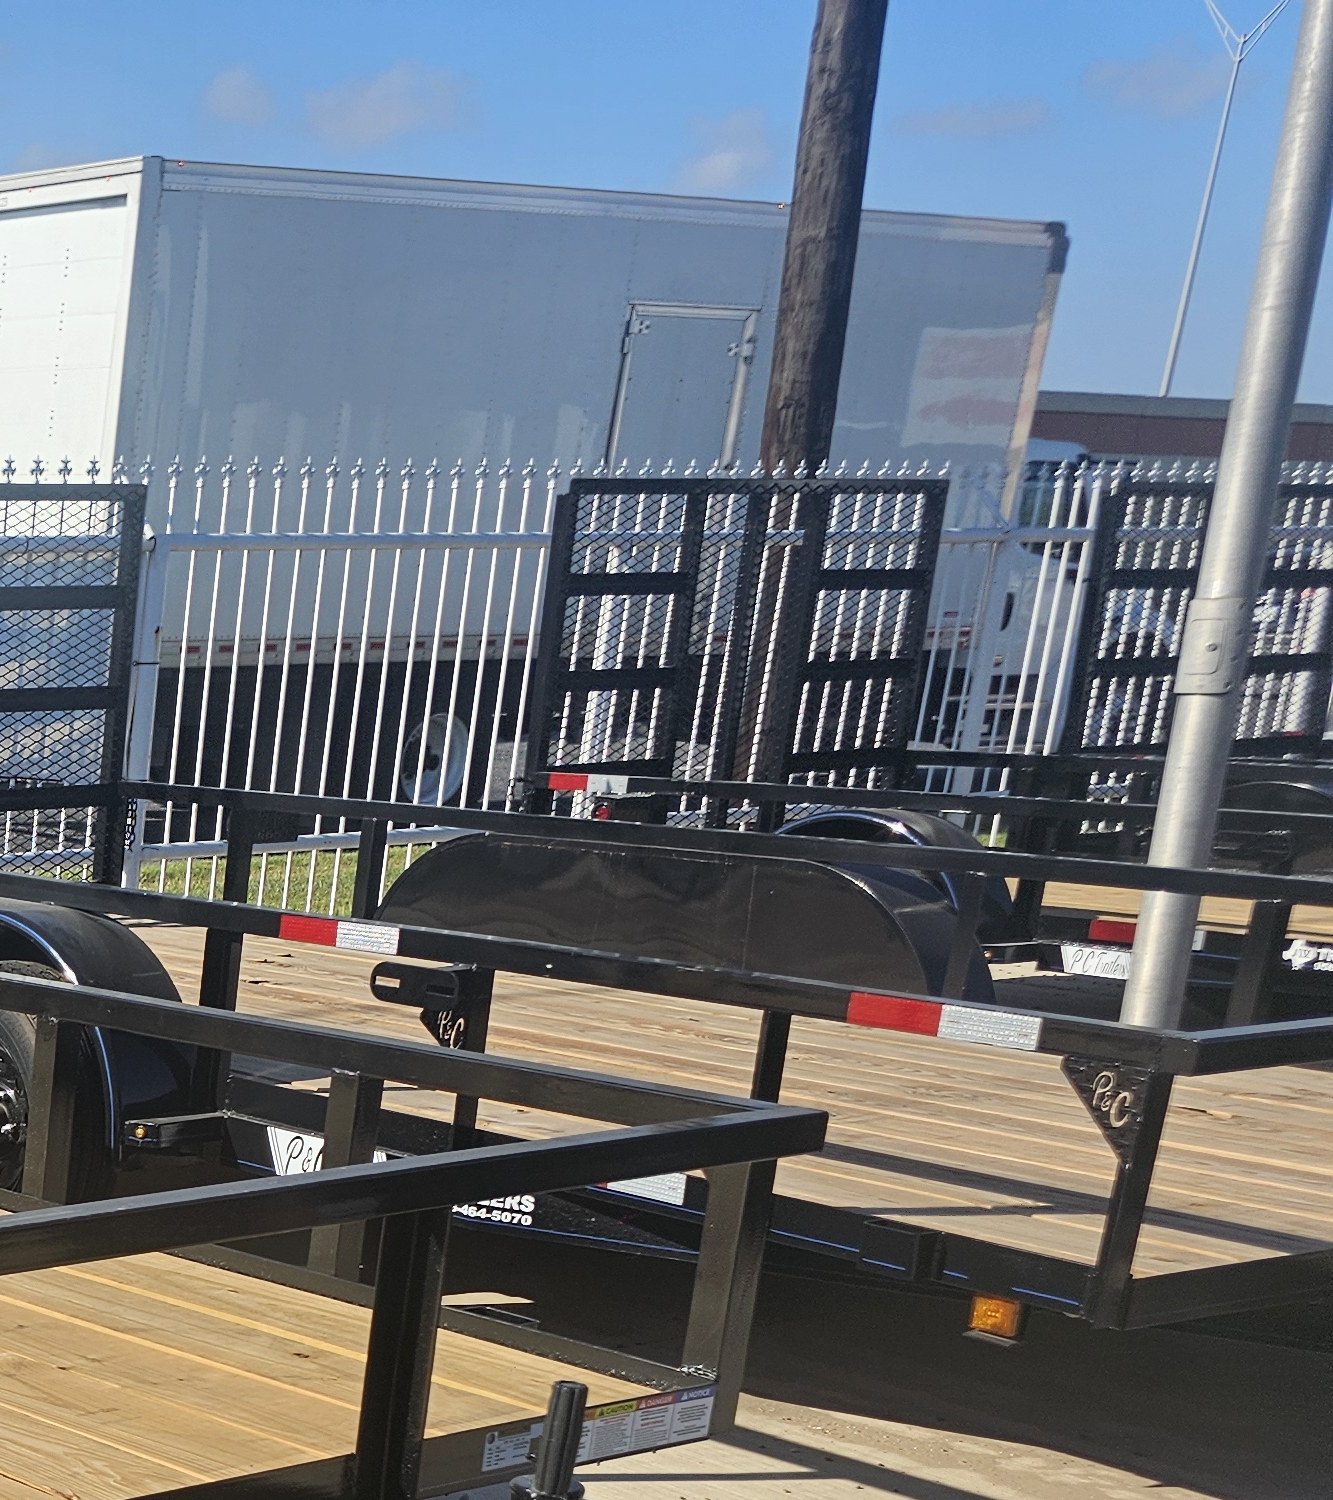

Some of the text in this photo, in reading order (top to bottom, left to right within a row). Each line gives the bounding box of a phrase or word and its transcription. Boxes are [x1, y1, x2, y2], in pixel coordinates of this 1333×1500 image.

[1093, 1071, 1131, 1128] P&C
[646, 1395, 672, 1407] DANGER
[604, 1403, 633, 1415] CAUTION
